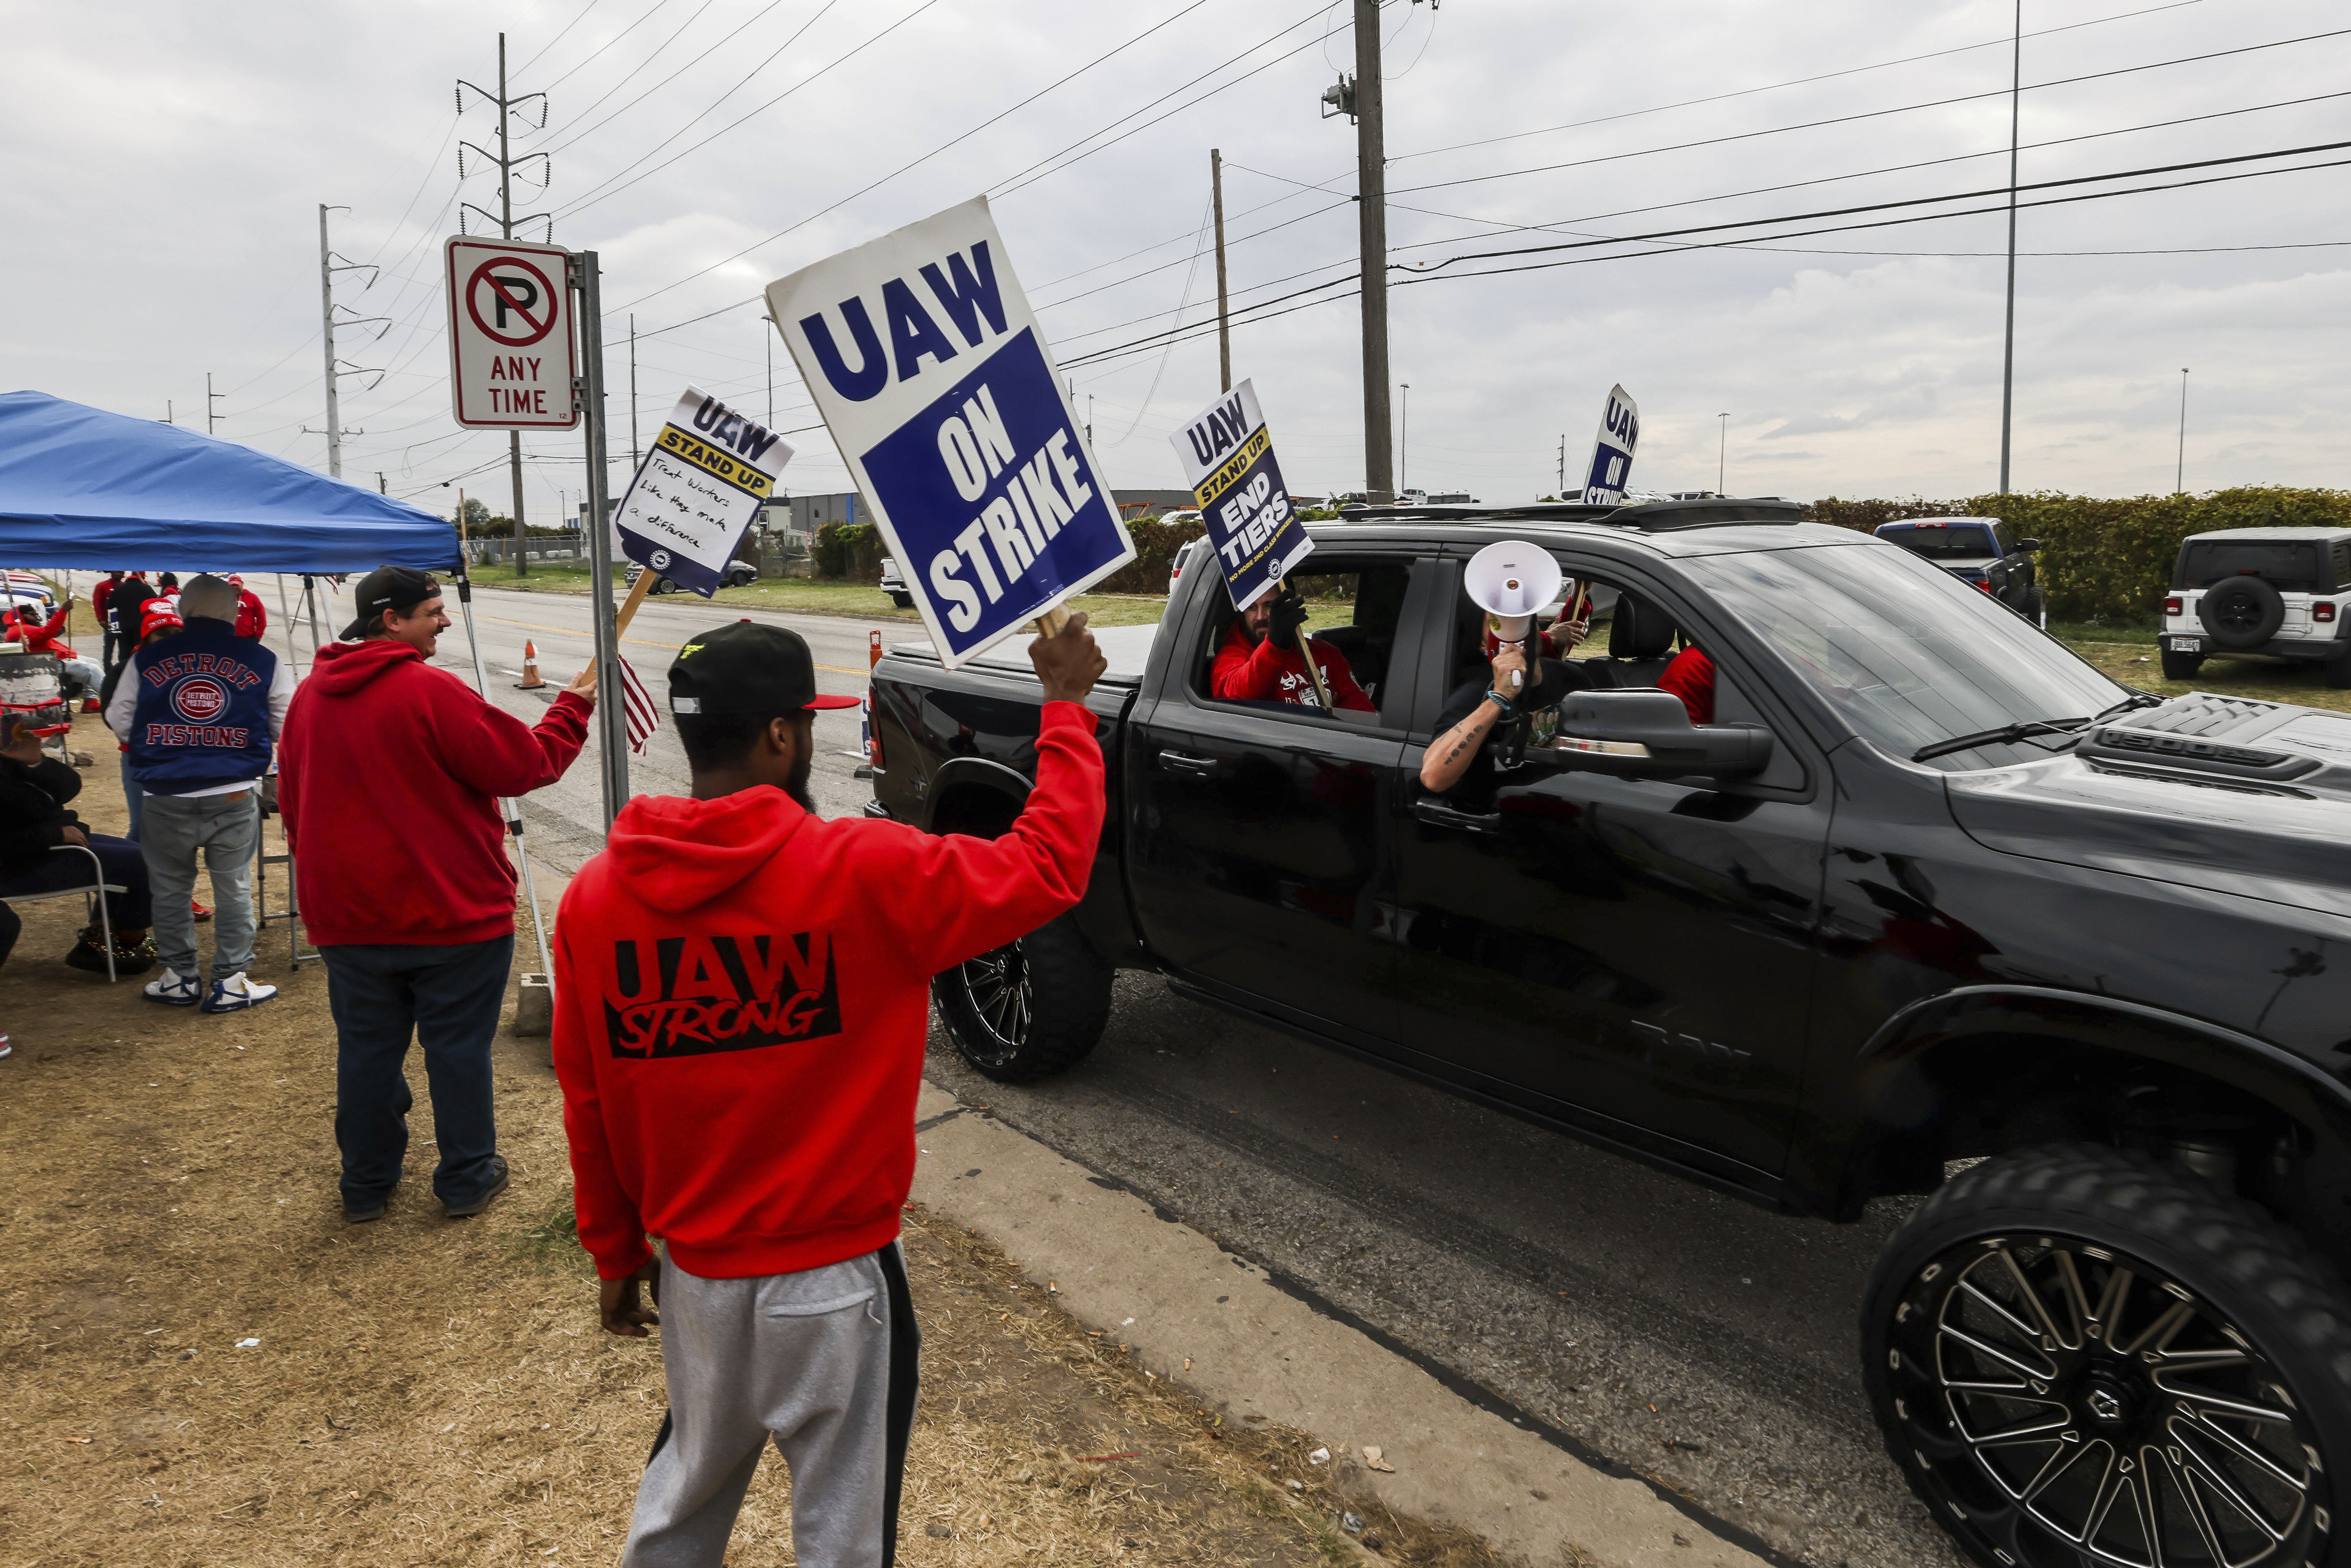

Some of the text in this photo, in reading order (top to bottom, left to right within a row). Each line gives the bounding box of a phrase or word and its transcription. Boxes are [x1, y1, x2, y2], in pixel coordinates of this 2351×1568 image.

[799, 240, 1008, 402] UAW
[491, 355, 541, 381] ANY
[488, 388, 548, 415] TIME
[693, 395, 780, 462] UAW
[1187, 392, 1248, 467] UAW
[1606, 395, 1639, 453] UAW
[652, 458, 682, 478] Treat
[664, 431, 766, 490] STAND UP
[937, 383, 1016, 502] ON
[1201, 433, 1265, 504] STAND UP
[1606, 456, 1624, 486] ON
[629, 508, 639, 517] a
[640, 479, 726, 532] Like they make
[929, 427, 1093, 633] STRIKE
[1219, 471, 1270, 534] END
[1220, 490, 1289, 568] TIERS
[1229, 573, 1238, 582] NO
[1238, 559, 1254, 575] MORE
[1253, 550, 1264, 563] 2ND
[1263, 536, 1277, 553] CLASS
[1275, 515, 1295, 538] WORKERS
[142, 653, 262, 690] DETROIT
[146, 723, 249, 749] PISTONS
[602, 930, 831, 1011] UAW
[618, 980, 826, 1059] STRONG
